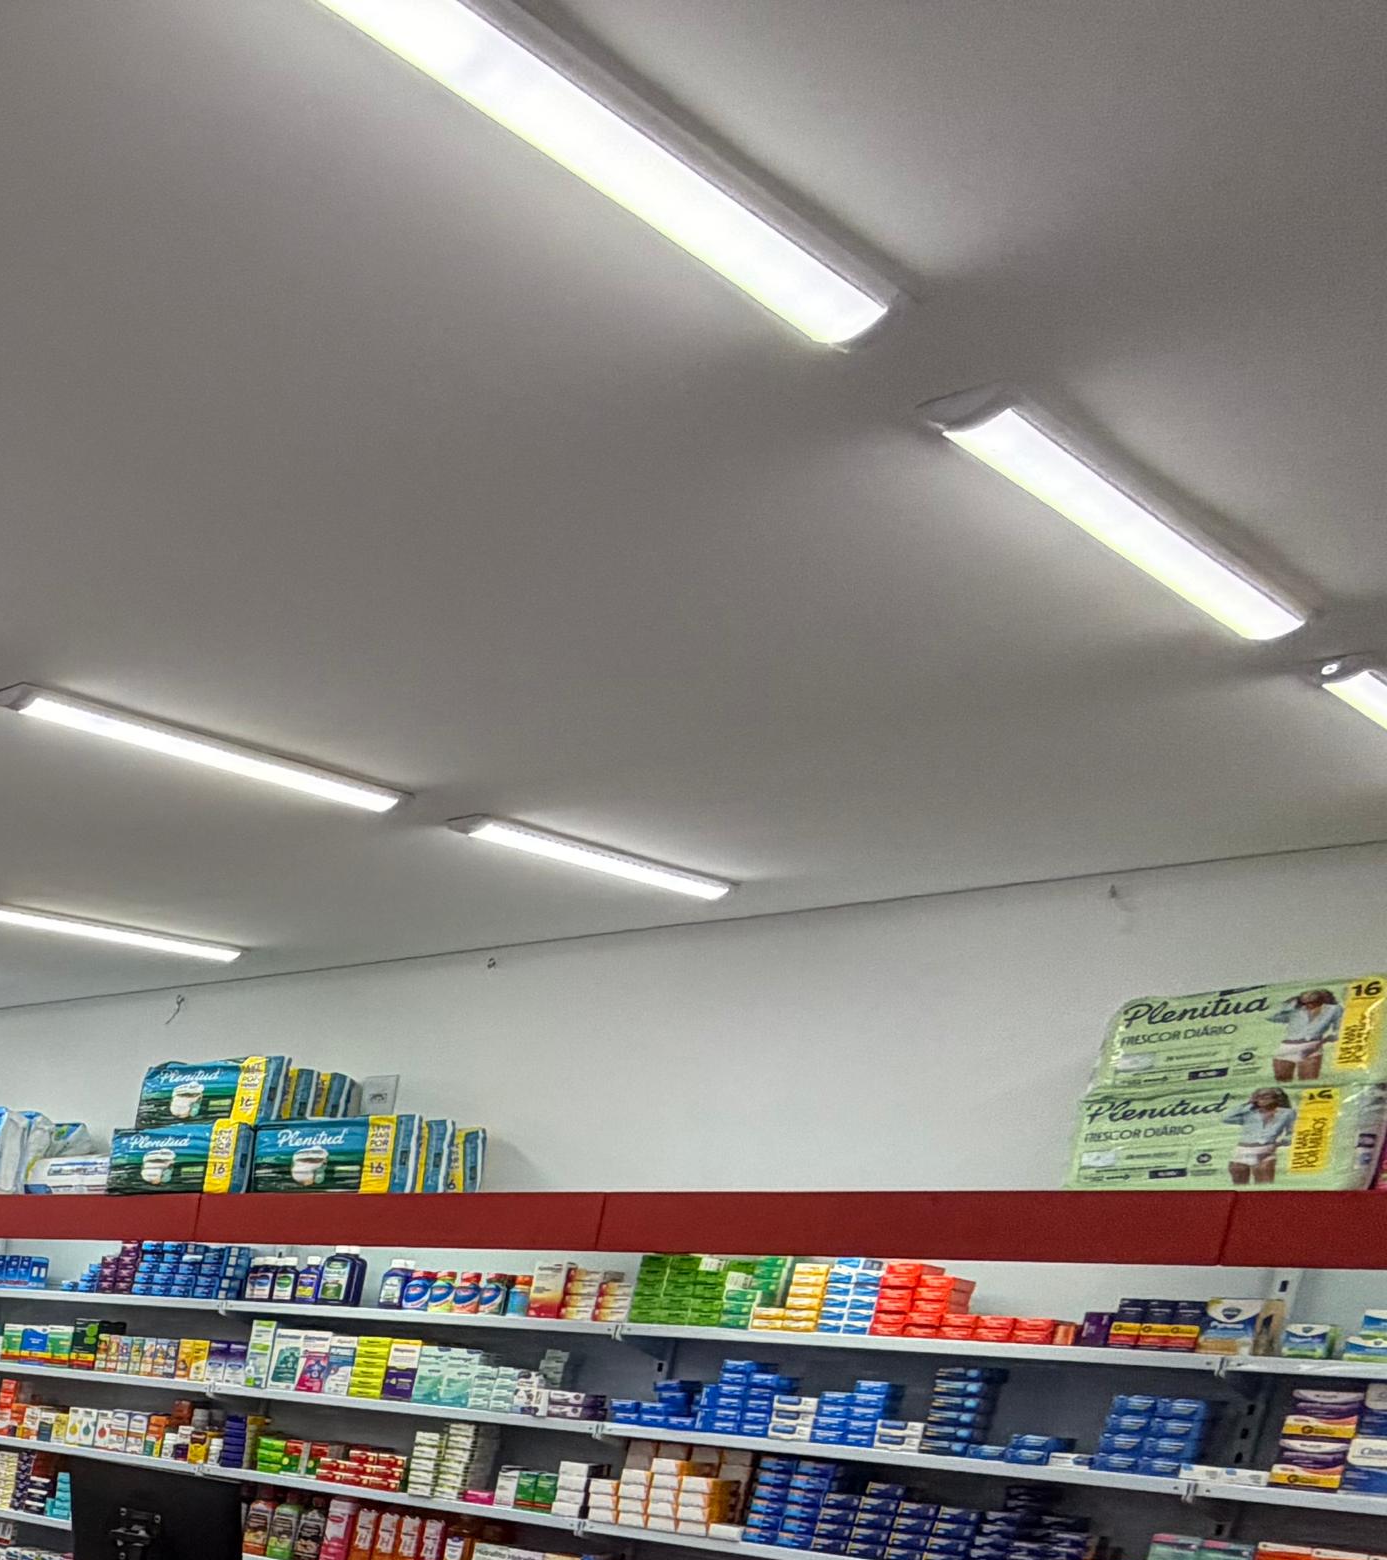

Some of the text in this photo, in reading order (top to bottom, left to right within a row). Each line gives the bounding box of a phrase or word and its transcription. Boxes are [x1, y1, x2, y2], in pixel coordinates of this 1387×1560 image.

[1351, 980, 1382, 997] 16
[1121, 1022, 1238, 1046] FRESCOR DIÁRIO
[159, 1069, 223, 1086] Plenitud
[1088, 1092, 1231, 1125] Plenitud
[129, 1132, 191, 1151] Plenitud
[277, 1128, 346, 1149] Plenitud
[1084, 1124, 1195, 1143] FRESCOR DIÁRIO
[213, 1162, 226, 1175] 16
[370, 1161, 384, 1175] 16
